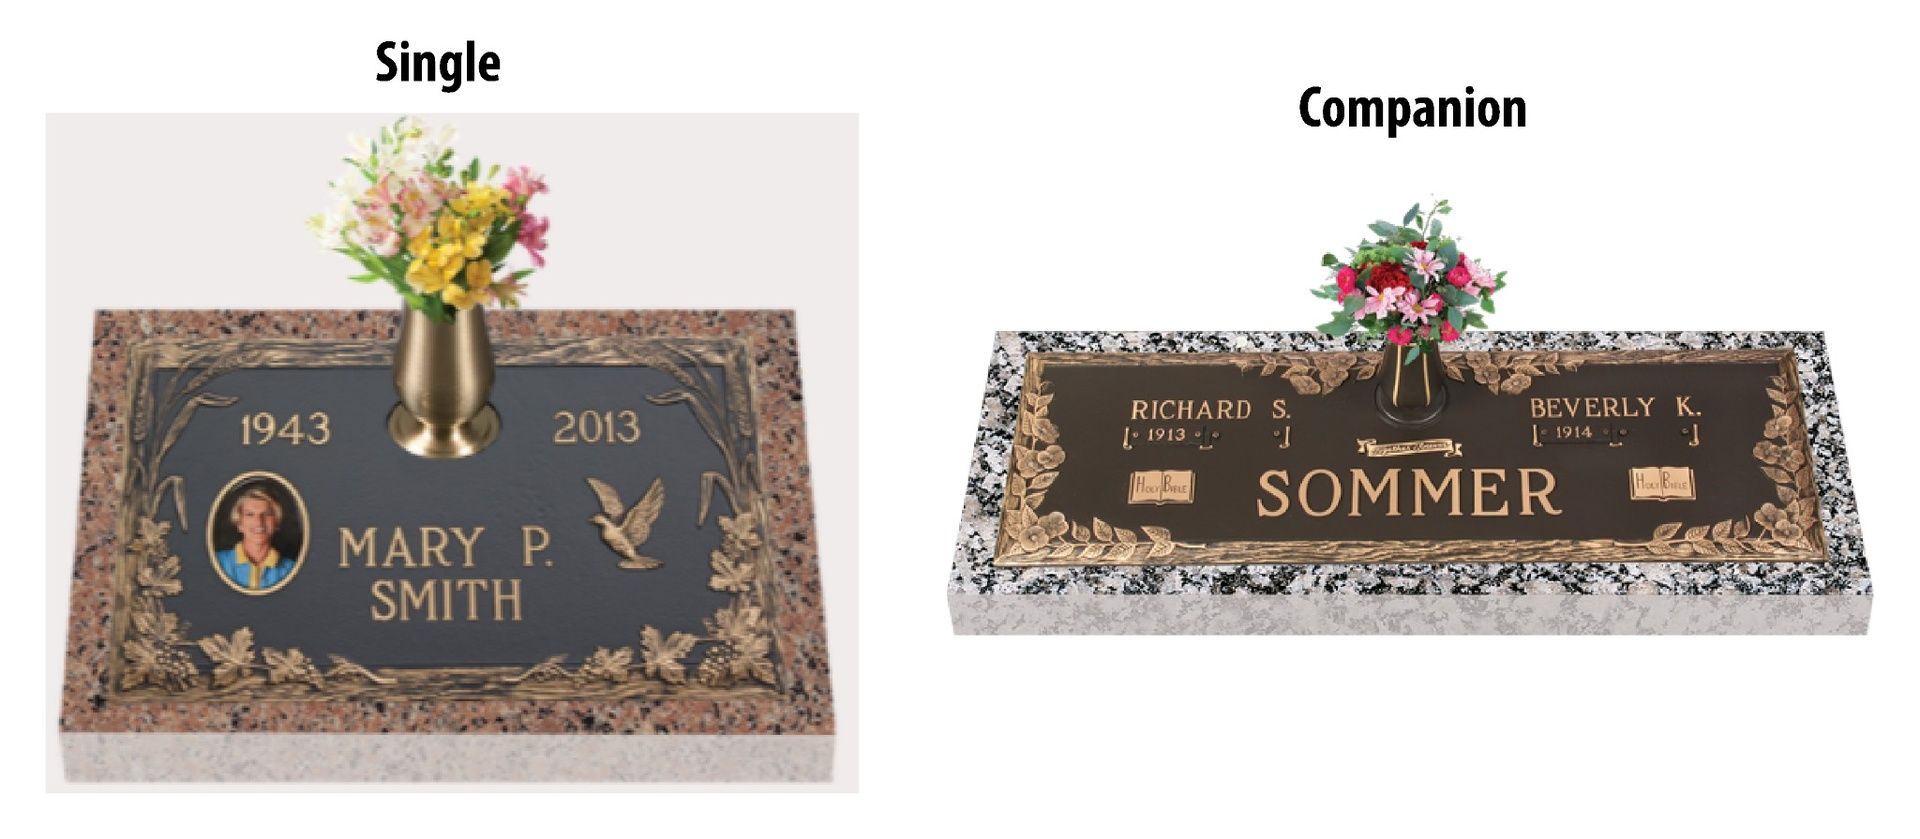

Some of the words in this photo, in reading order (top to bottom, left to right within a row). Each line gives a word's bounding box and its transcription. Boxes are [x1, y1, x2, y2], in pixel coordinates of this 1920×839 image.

[1131, 399, 1252, 420] RICHARD
[1272, 398, 1291, 419] S.
[1530, 397, 1655, 418] BEVERLY
[1675, 396, 1702, 417] K.
[241, 411, 331, 446] 1943
[553, 409, 641, 444] 2013
[1147, 428, 1185, 441] 1913
[1556, 426, 1593, 438] 1914
[1257, 468, 1563, 517] SOMMER
[338, 526, 485, 568] MARY
[521, 526, 554, 568] P.
[371, 579, 522, 621] SMITH
